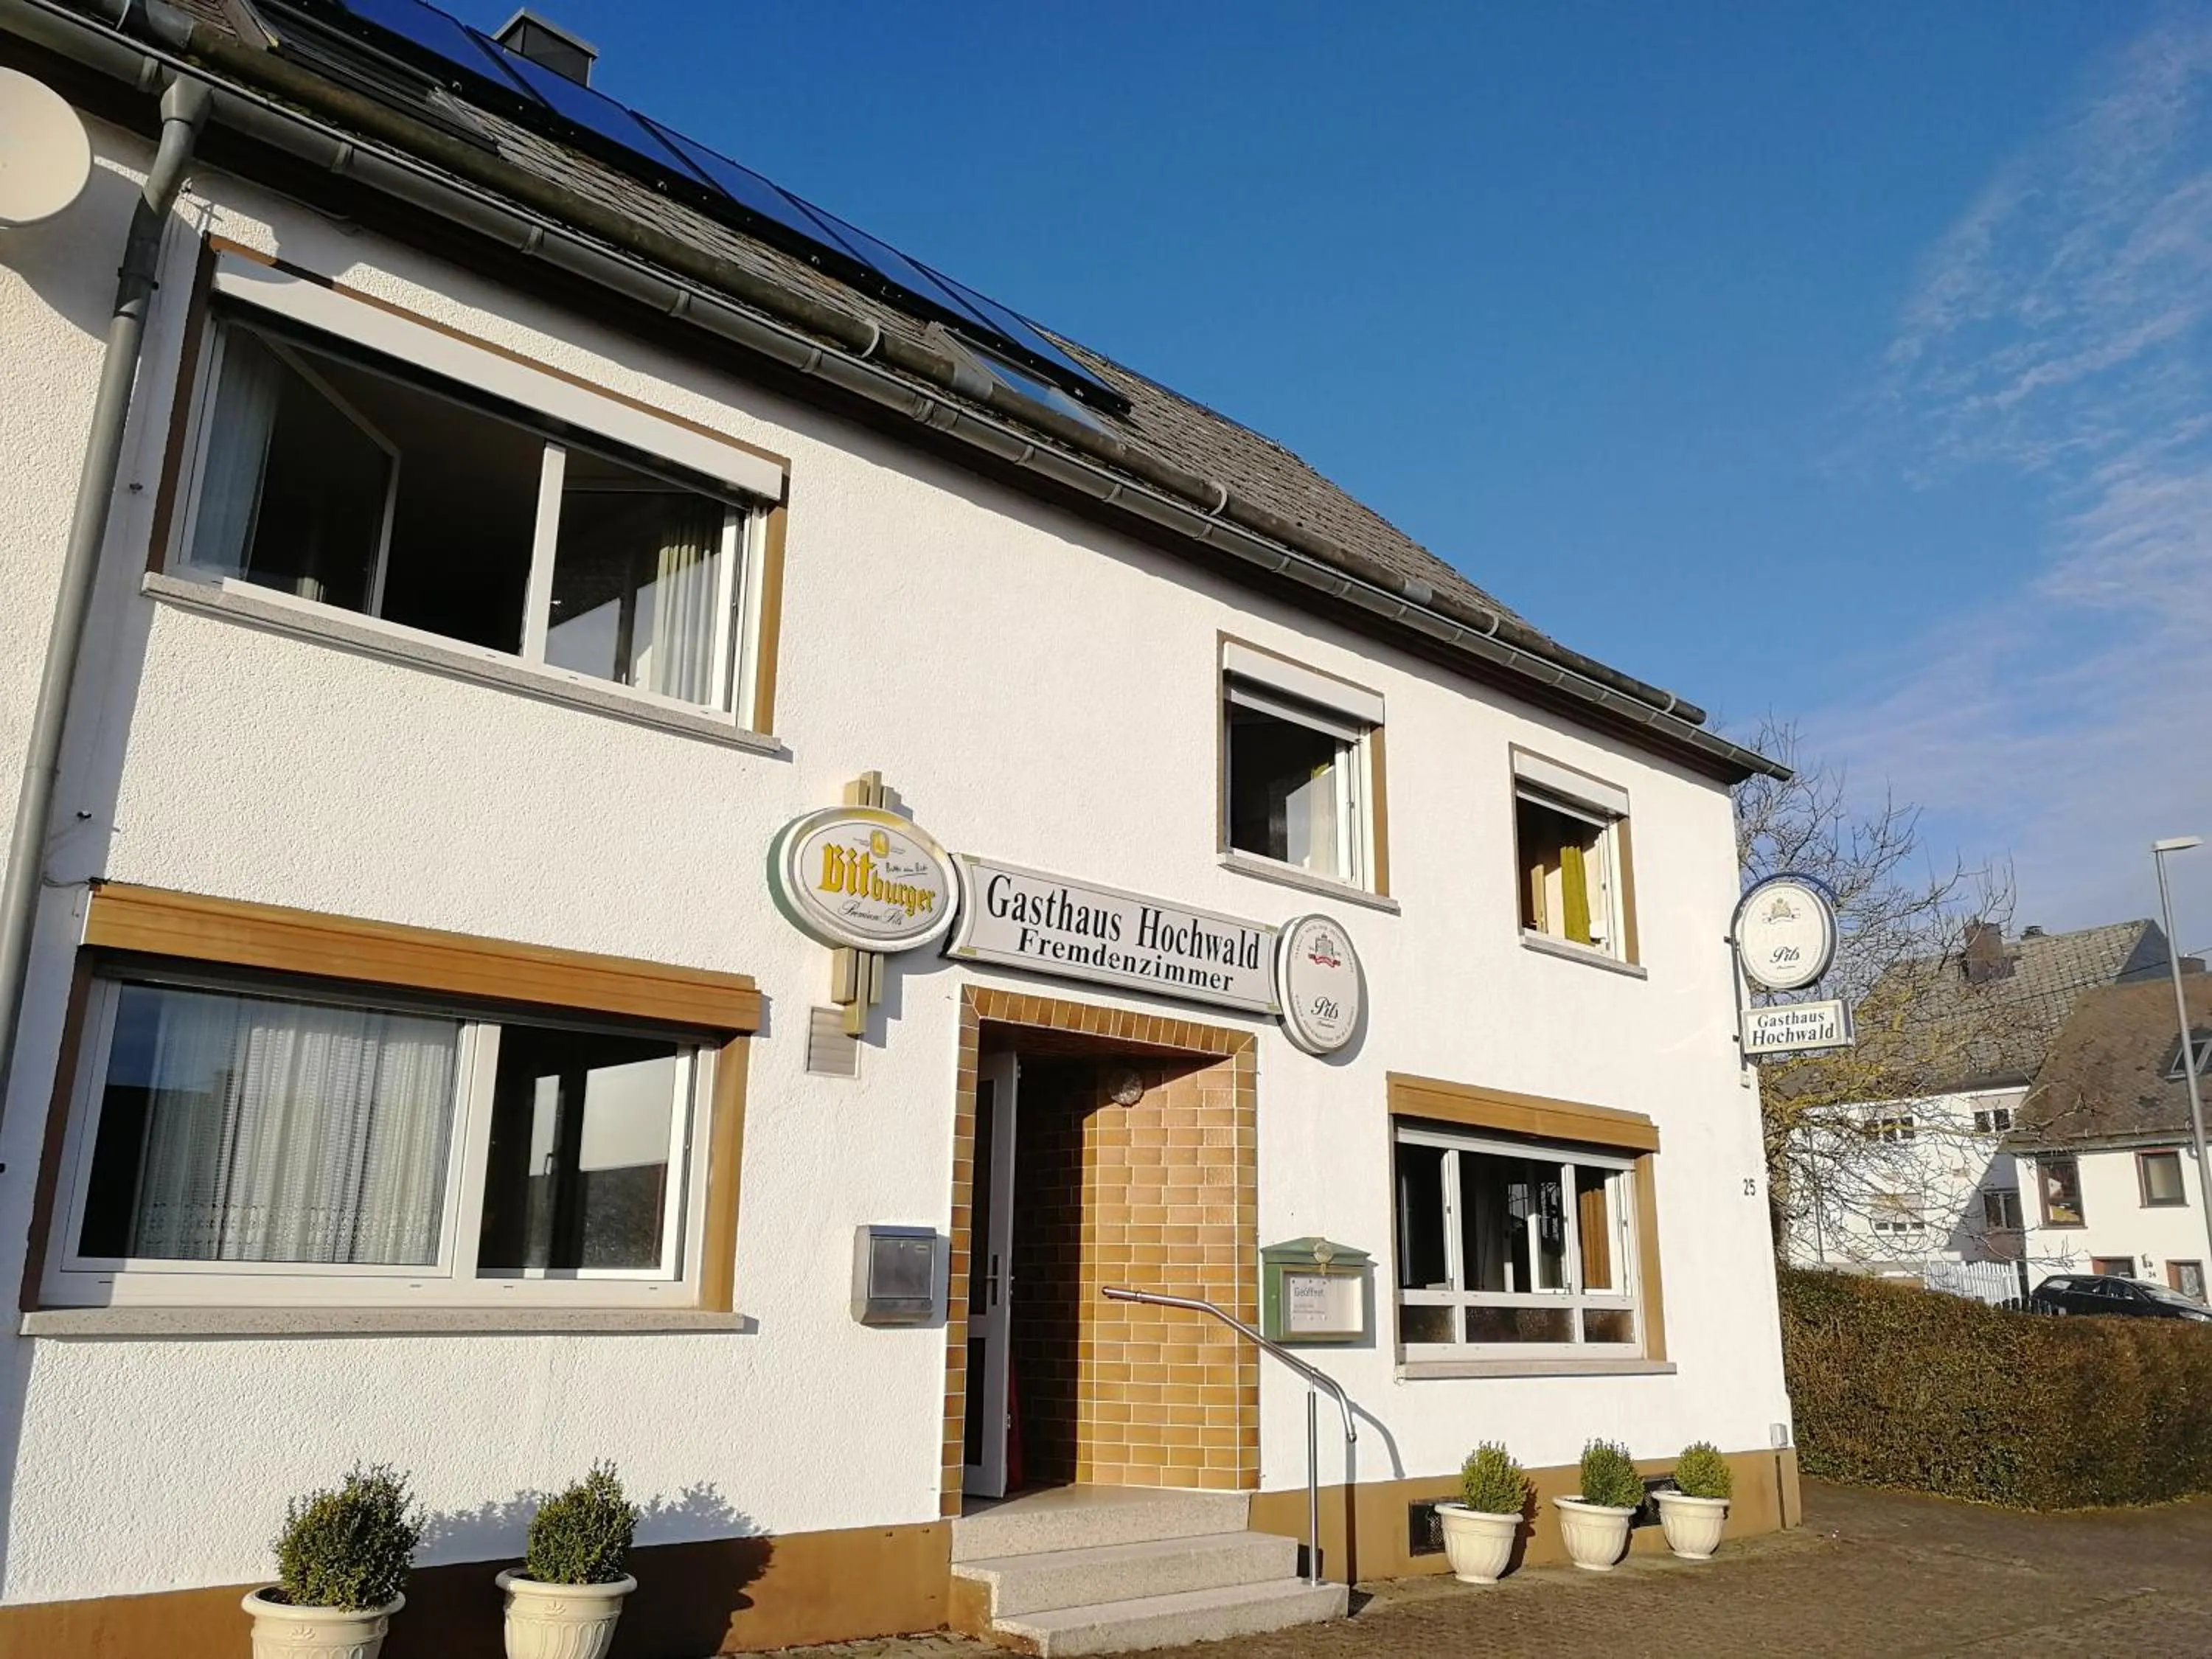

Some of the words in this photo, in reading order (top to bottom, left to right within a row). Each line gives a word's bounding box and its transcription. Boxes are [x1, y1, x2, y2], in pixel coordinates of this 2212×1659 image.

[818, 843, 936, 917] Bitburger
[987, 874, 1122, 942] Gasthaus
[1135, 906, 1261, 970] Hochwald
[1016, 927, 1234, 992] Fremdenzimmer
[1770, 946, 1801, 963] Pils
[1310, 996, 1339, 1019] Pils
[1757, 1011, 1825, 1029] Gasthaus
[1752, 1023, 1834, 1046] Hochwald
[1743, 1178, 1756, 1196] 25
